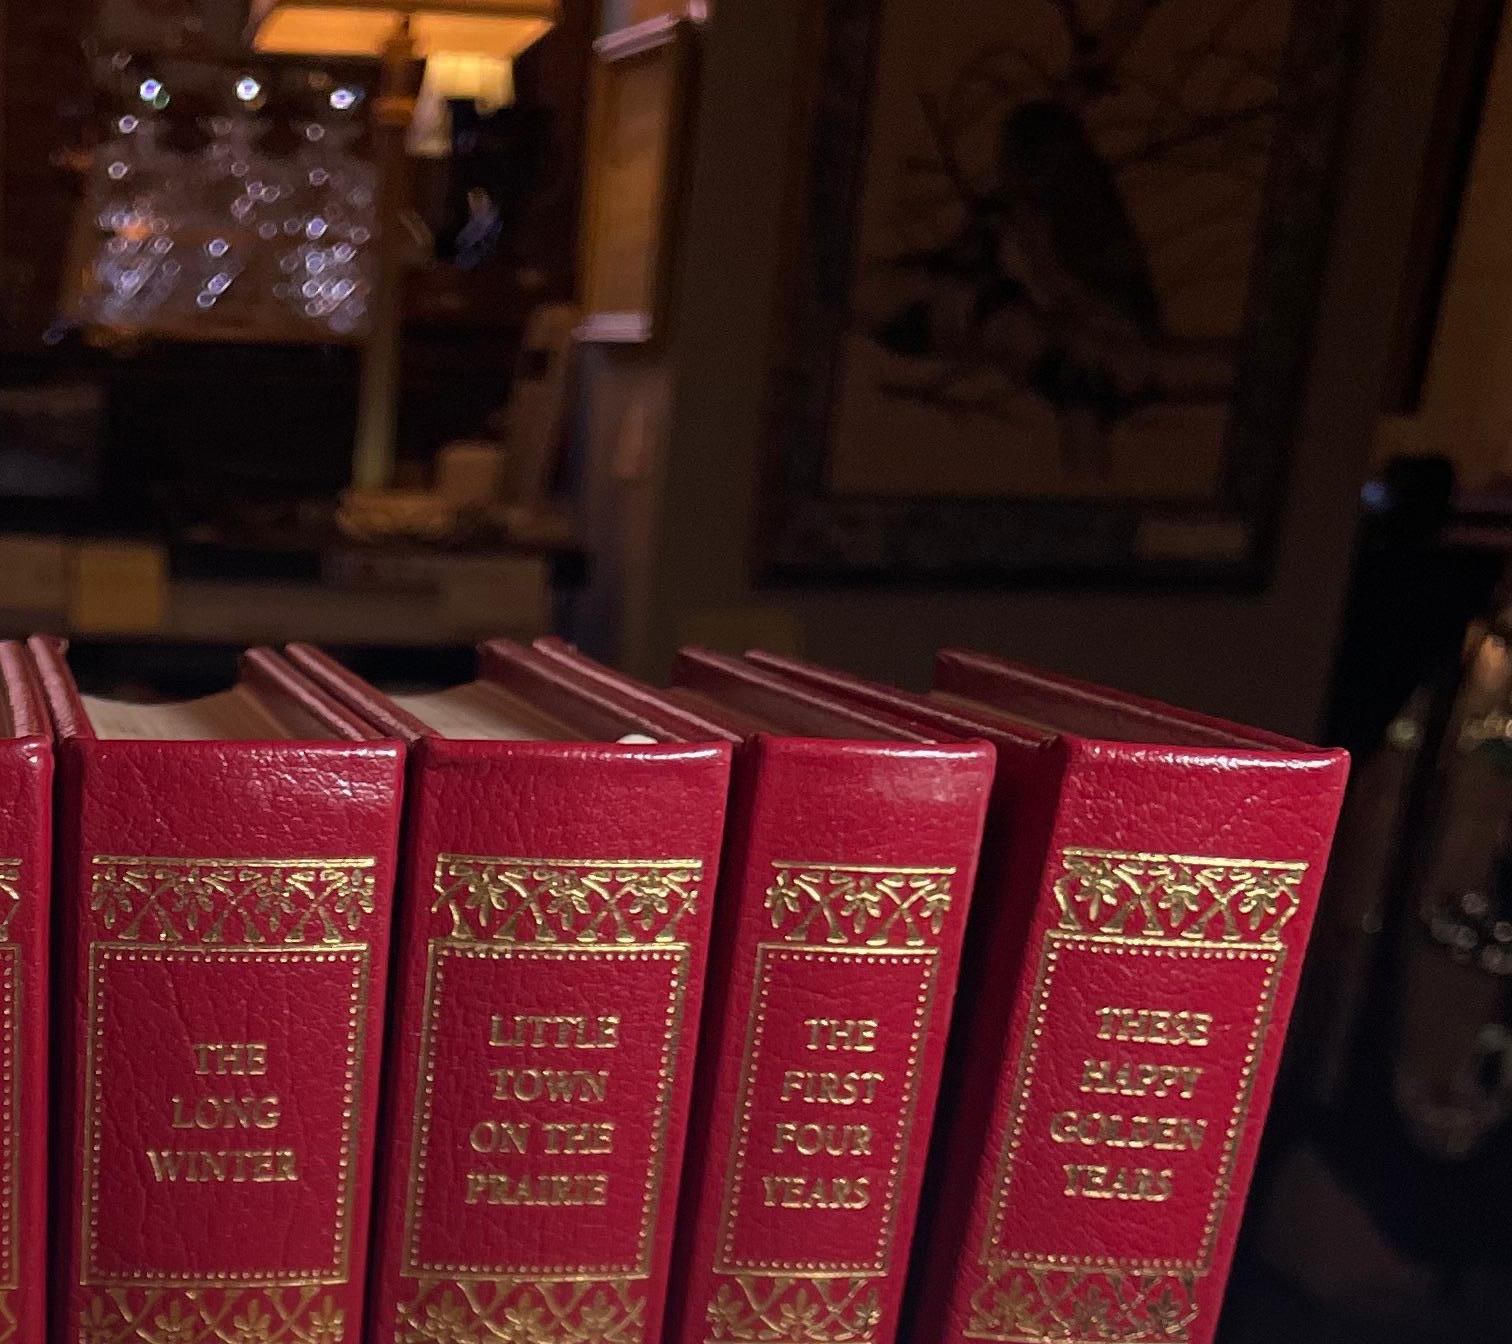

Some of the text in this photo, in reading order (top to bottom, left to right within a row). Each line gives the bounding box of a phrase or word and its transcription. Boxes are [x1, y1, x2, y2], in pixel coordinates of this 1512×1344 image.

[489, 1015, 620, 1048] LITTLE
[804, 1018, 879, 1051] THE
[1095, 1007, 1213, 1047] THESE
[193, 1043, 267, 1075] THE
[489, 1069, 610, 1102] TOWN
[779, 1071, 884, 1105] FIRST
[1079, 1059, 1204, 1099] HAPPY
[171, 1096, 281, 1129] LONG
[470, 1121, 615, 1155] ON THE
[772, 1123, 872, 1156] FOUR
[1050, 1111, 1208, 1150] GOLDEN
[146, 1149, 298, 1183] WINTER
[1063, 1164, 1173, 1201] YEARS
[465, 1173, 609, 1206] PRAIRIE
[762, 1177, 870, 1209] YEARS
